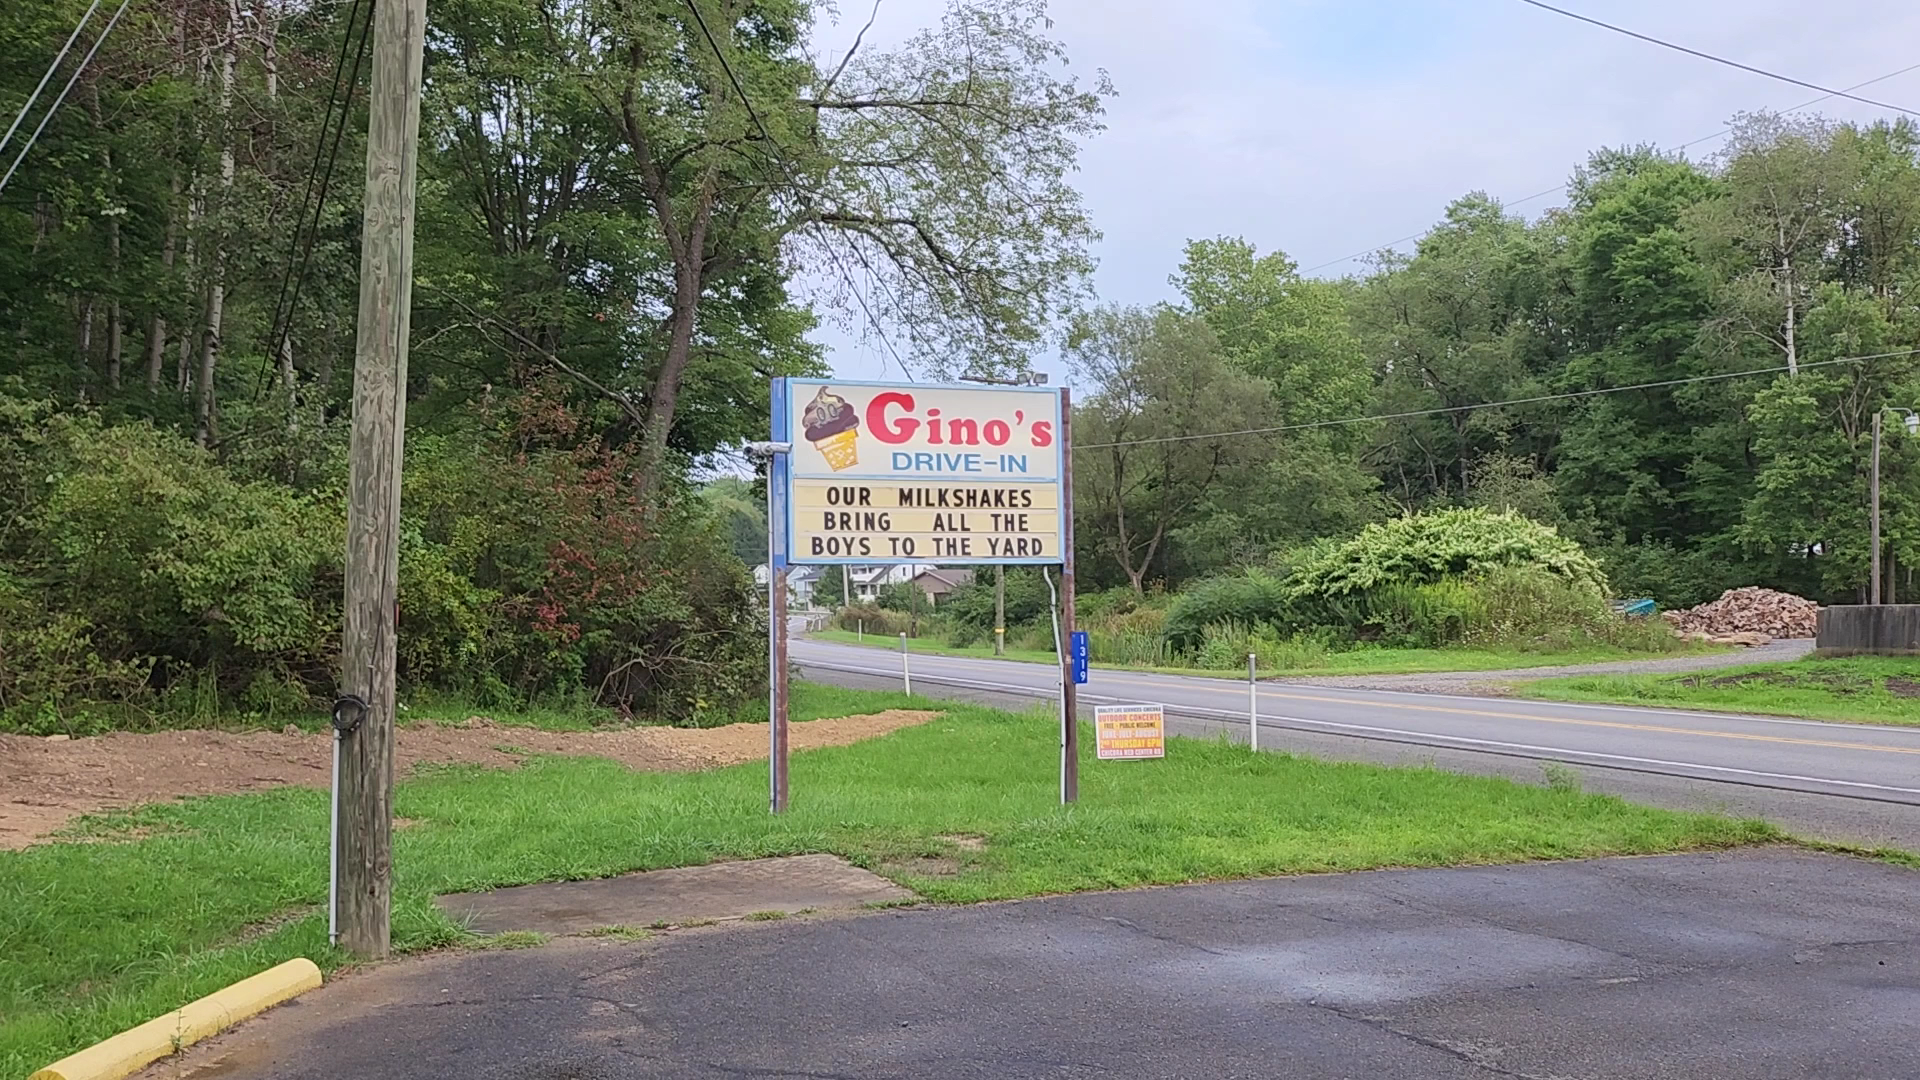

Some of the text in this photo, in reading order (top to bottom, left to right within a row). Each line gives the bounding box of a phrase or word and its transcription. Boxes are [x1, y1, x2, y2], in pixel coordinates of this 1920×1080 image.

[865, 392, 1052, 447] Gino's
[892, 452, 1028, 473] DRIVE-IN
[826, 486, 1032, 508] OUR MILKSHAKES
[823, 511, 1029, 532] BRING ALL THE
[811, 537, 1043, 557] BOYS TO THE YARD
[1098, 713, 1161, 722] OUTDOOR CONCERTS
[1111, 739, 1145, 748] THURSDAY
